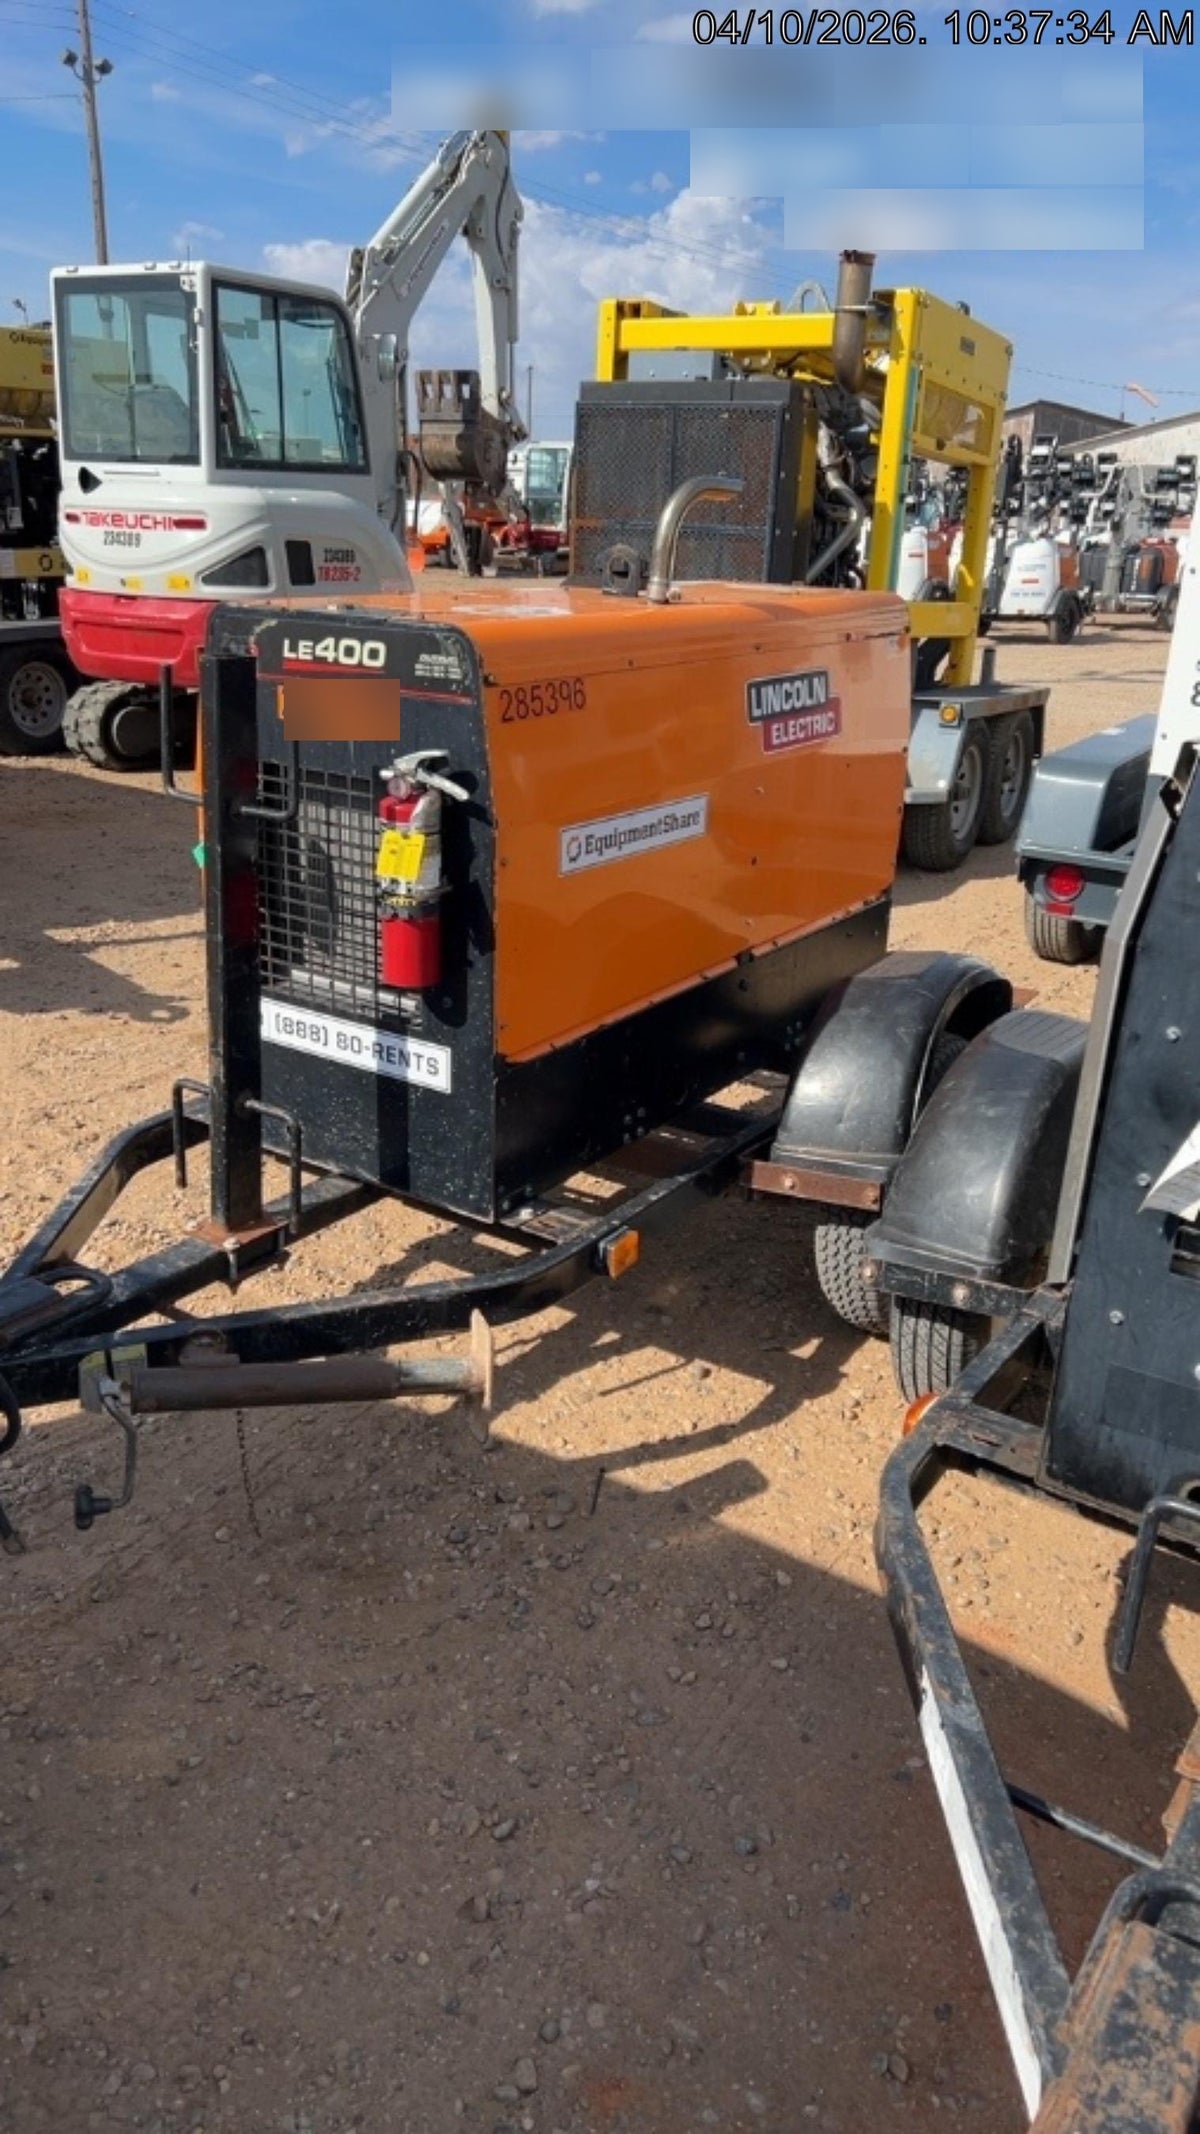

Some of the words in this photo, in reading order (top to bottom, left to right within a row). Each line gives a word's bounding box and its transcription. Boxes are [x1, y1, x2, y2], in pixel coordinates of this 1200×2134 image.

[283, 636, 388, 668] LE400
[500, 677, 586, 723] 285396
[750, 675, 826, 717] LINCOLN
[770, 711, 836, 745] ELECTRIC
[584, 810, 701, 856] EquipmentShare
[273, 1012, 328, 1047] (888)
[335, 1031, 440, 1076] 80-RENTS
